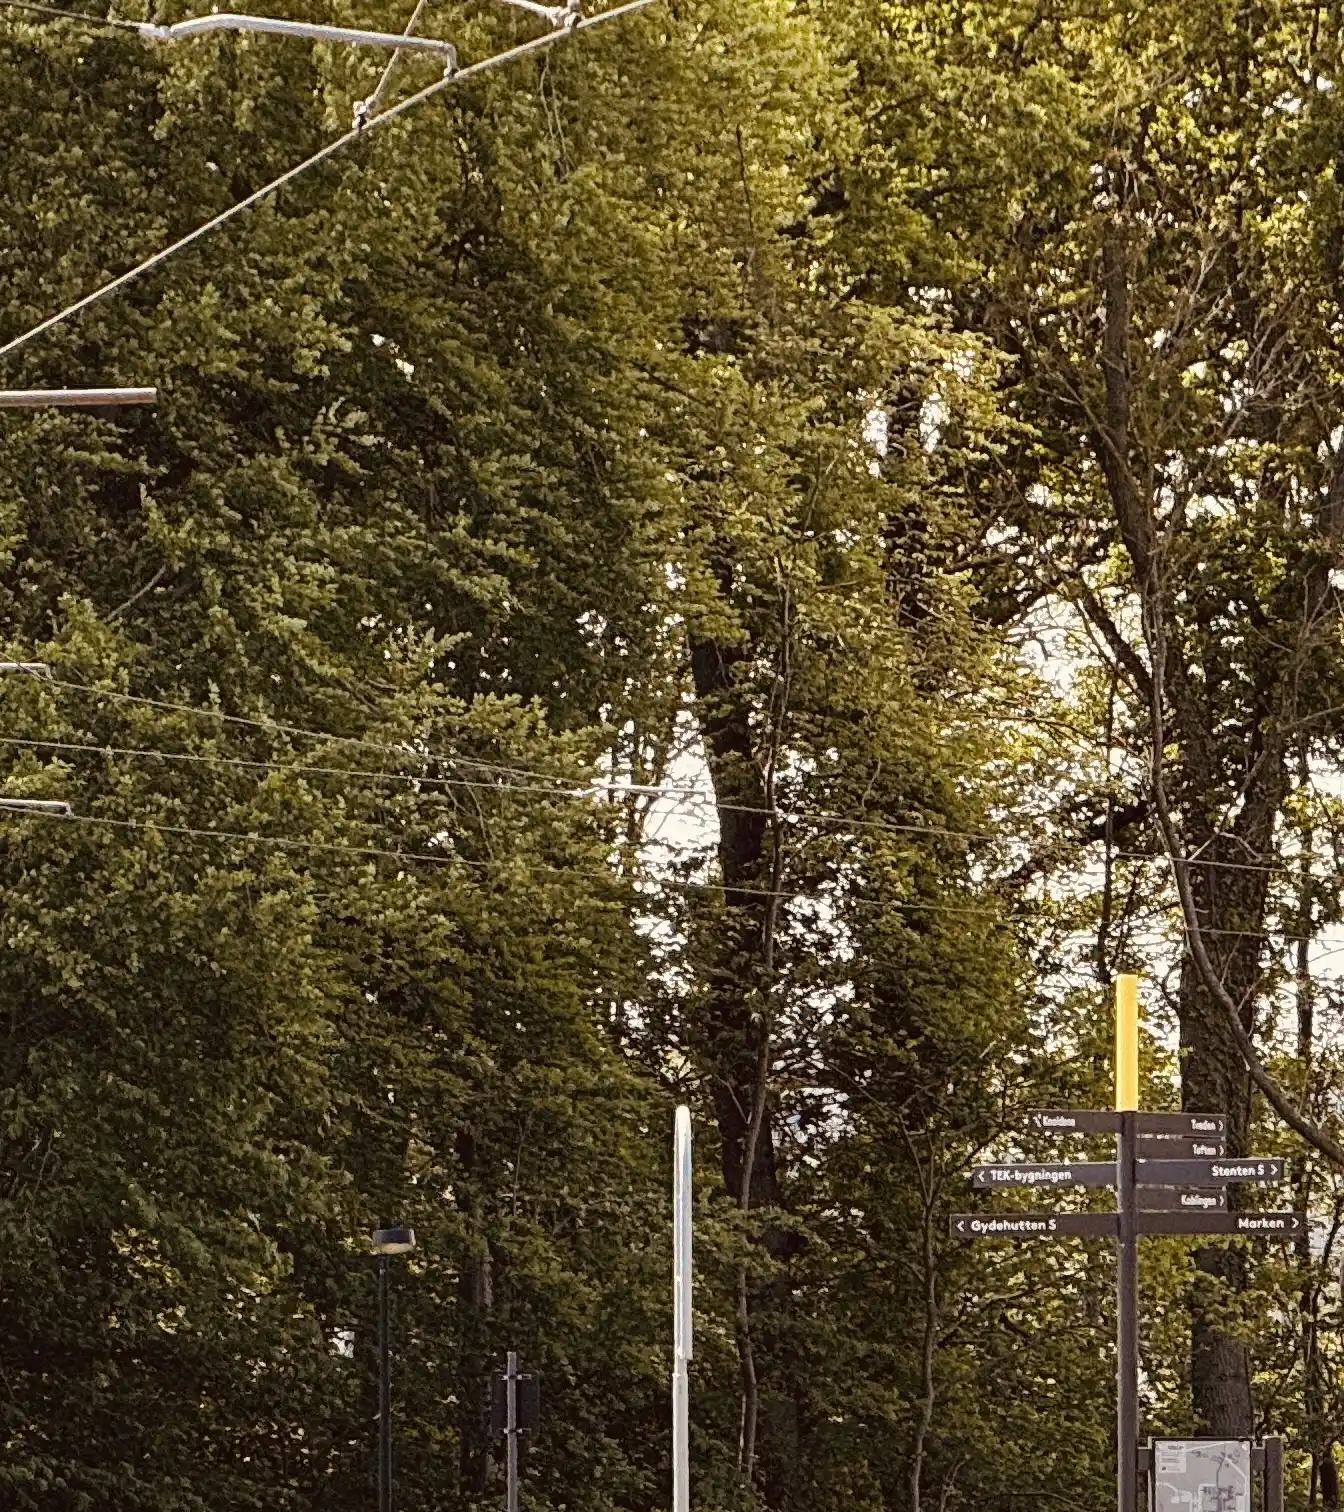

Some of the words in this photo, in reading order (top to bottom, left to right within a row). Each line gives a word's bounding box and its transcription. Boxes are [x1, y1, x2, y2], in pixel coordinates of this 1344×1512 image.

[990, 1169, 1073, 1184] TEK-bygningen
[1212, 1164, 1256, 1177] Stenten
[970, 1219, 1047, 1234] Gydehutten
[1238, 1218, 1285, 1229] Marken
